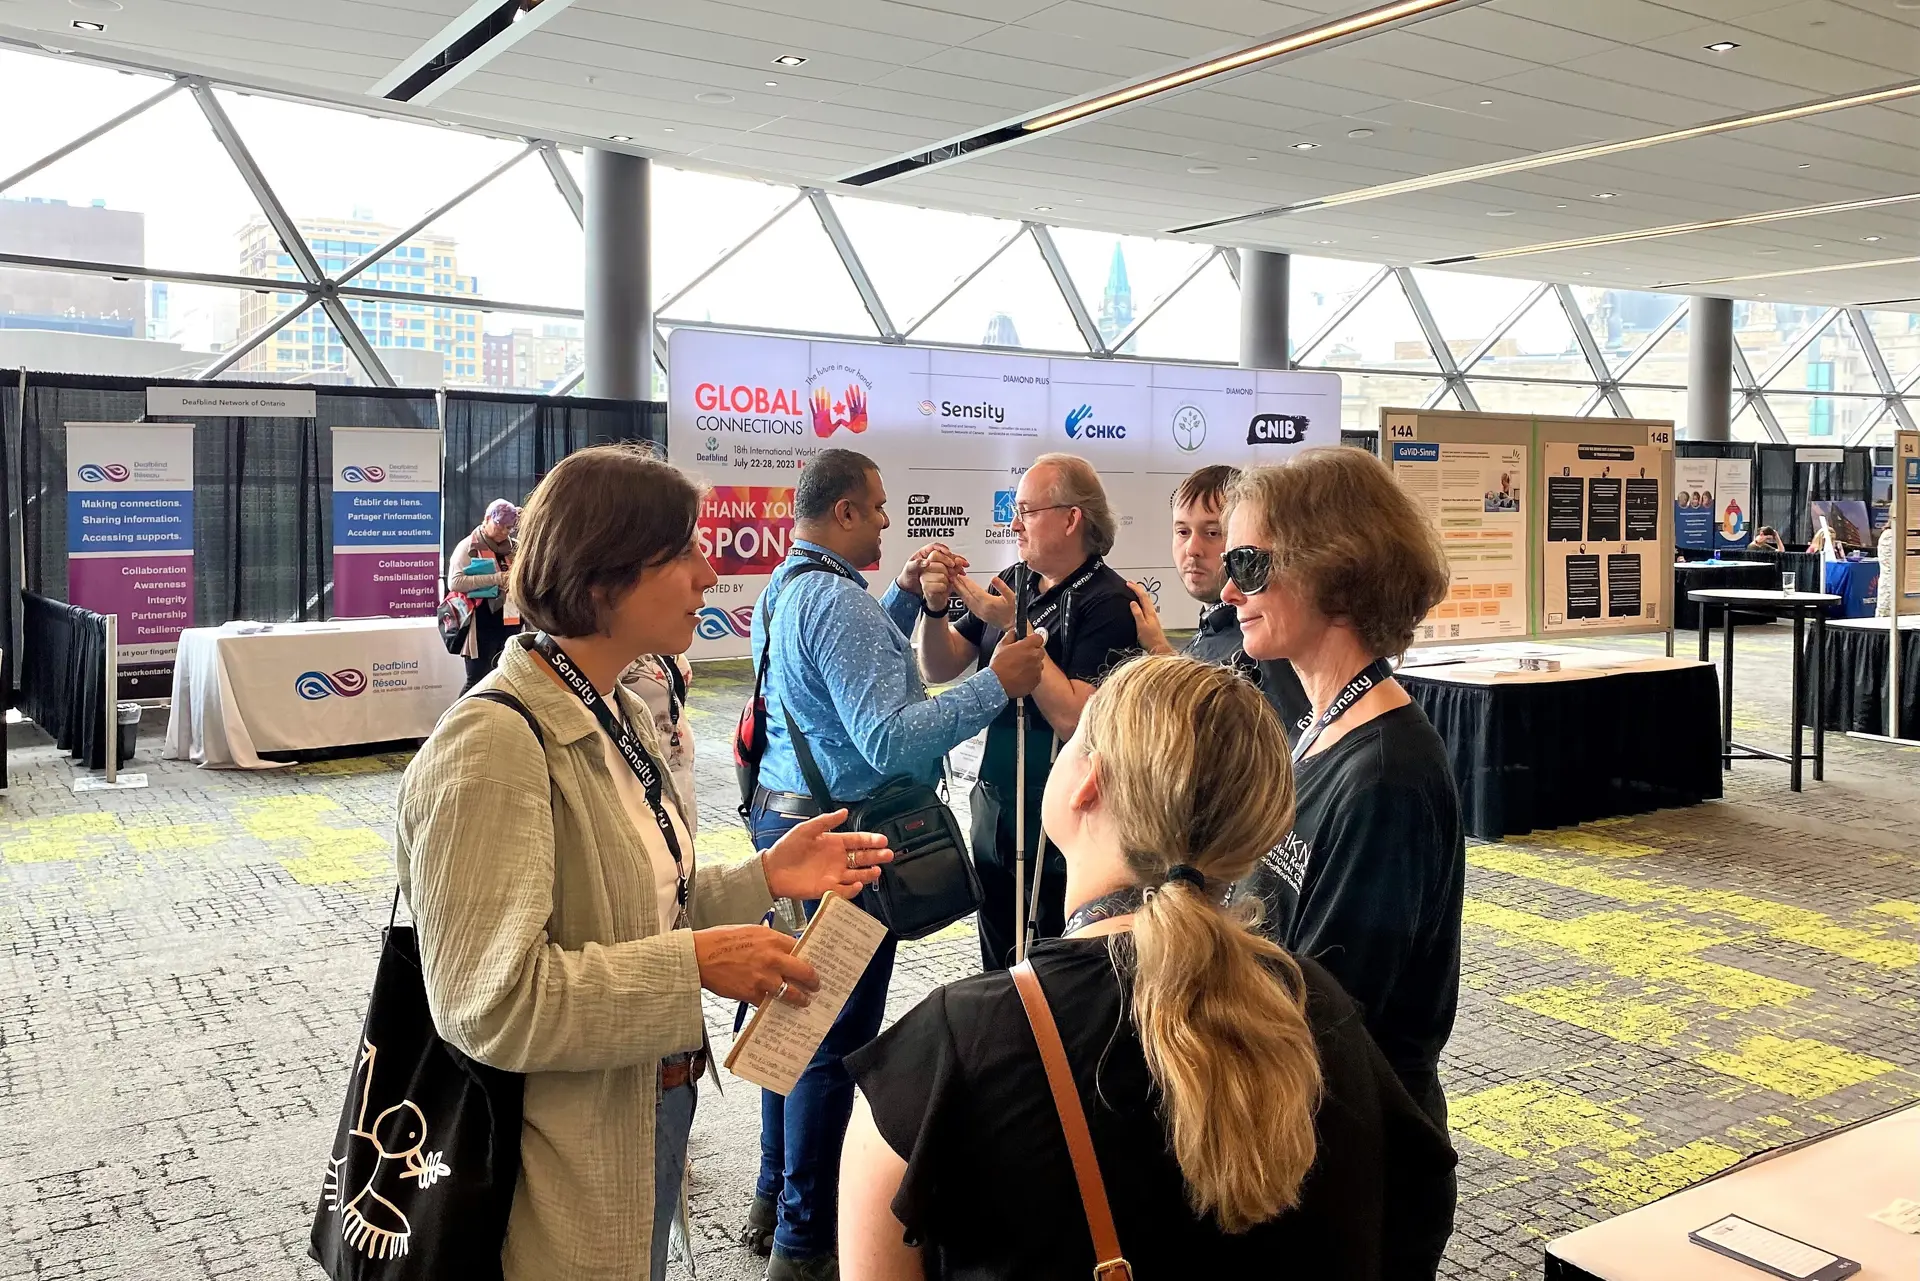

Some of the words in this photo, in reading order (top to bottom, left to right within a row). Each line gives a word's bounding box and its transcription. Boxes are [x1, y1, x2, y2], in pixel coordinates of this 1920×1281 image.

[805, 374, 817, 386] The
[816, 364, 835, 376] future
[837, 361, 843, 371] in
[844, 366, 856, 374] our
[856, 369, 873, 390] hands
[1003, 375, 1034, 384] DIAMOND
[1035, 377, 1050, 385] PLUS
[1226, 387, 1253, 395] DIAMOND
[182, 399, 216, 407] Deafblind
[219, 399, 249, 407] Network
[695, 382, 803, 416] GLOBAL
[941, 401, 1005, 423] Sensity
[696, 415, 803, 435] CONNECTIONS
[1255, 419, 1296, 439] CNIB
[1085, 425, 1126, 439] CHKC
[1391, 426, 1413, 438] 14A
[1651, 432, 1669, 443] 14B
[734, 445, 748, 454] 18th
[750, 446, 793, 456] International
[795, 448, 816, 456] World
[697, 453, 728, 462] Deafblind
[734, 458, 748, 470] July
[750, 459, 775, 469] 22-28,
[777, 460, 795, 469] 2023
[82, 500, 117, 509] Making
[120, 499, 182, 508] connections.
[354, 497, 381, 506] Établir
[400, 498, 423, 506] liens.
[699, 501, 756, 519] THANK
[908, 506, 964, 516] DEAFBLIND
[82, 515, 121, 525] Sharing
[124, 514, 182, 524] information.
[348, 513, 381, 521] Partager
[908, 517, 970, 526] COMMUNITY
[82, 533, 134, 543] Accessing
[136, 532, 182, 543] supports.
[348, 529, 380, 537] Accéder
[907, 528, 955, 537] SERVICES
[378, 560, 434, 568] Collaboration
[122, 565, 187, 576] Collaboration
[373, 574, 434, 582] Sensibilisation
[134, 581, 187, 590] Awareness
[733, 584, 744, 593] BY
[400, 587, 434, 596] Intégrité
[147, 595, 187, 606] Integrity
[389, 601, 435, 609] Partenariat
[131, 610, 187, 621] Partnership
[131, 650, 148, 658] your
[372, 660, 419, 671] Deafblind
[372, 679, 407, 688] Réseau
[552, 653, 596, 706] Sensity
[618, 734, 656, 787] Sensity
[1267, 850, 1294, 876] ATIONAL
